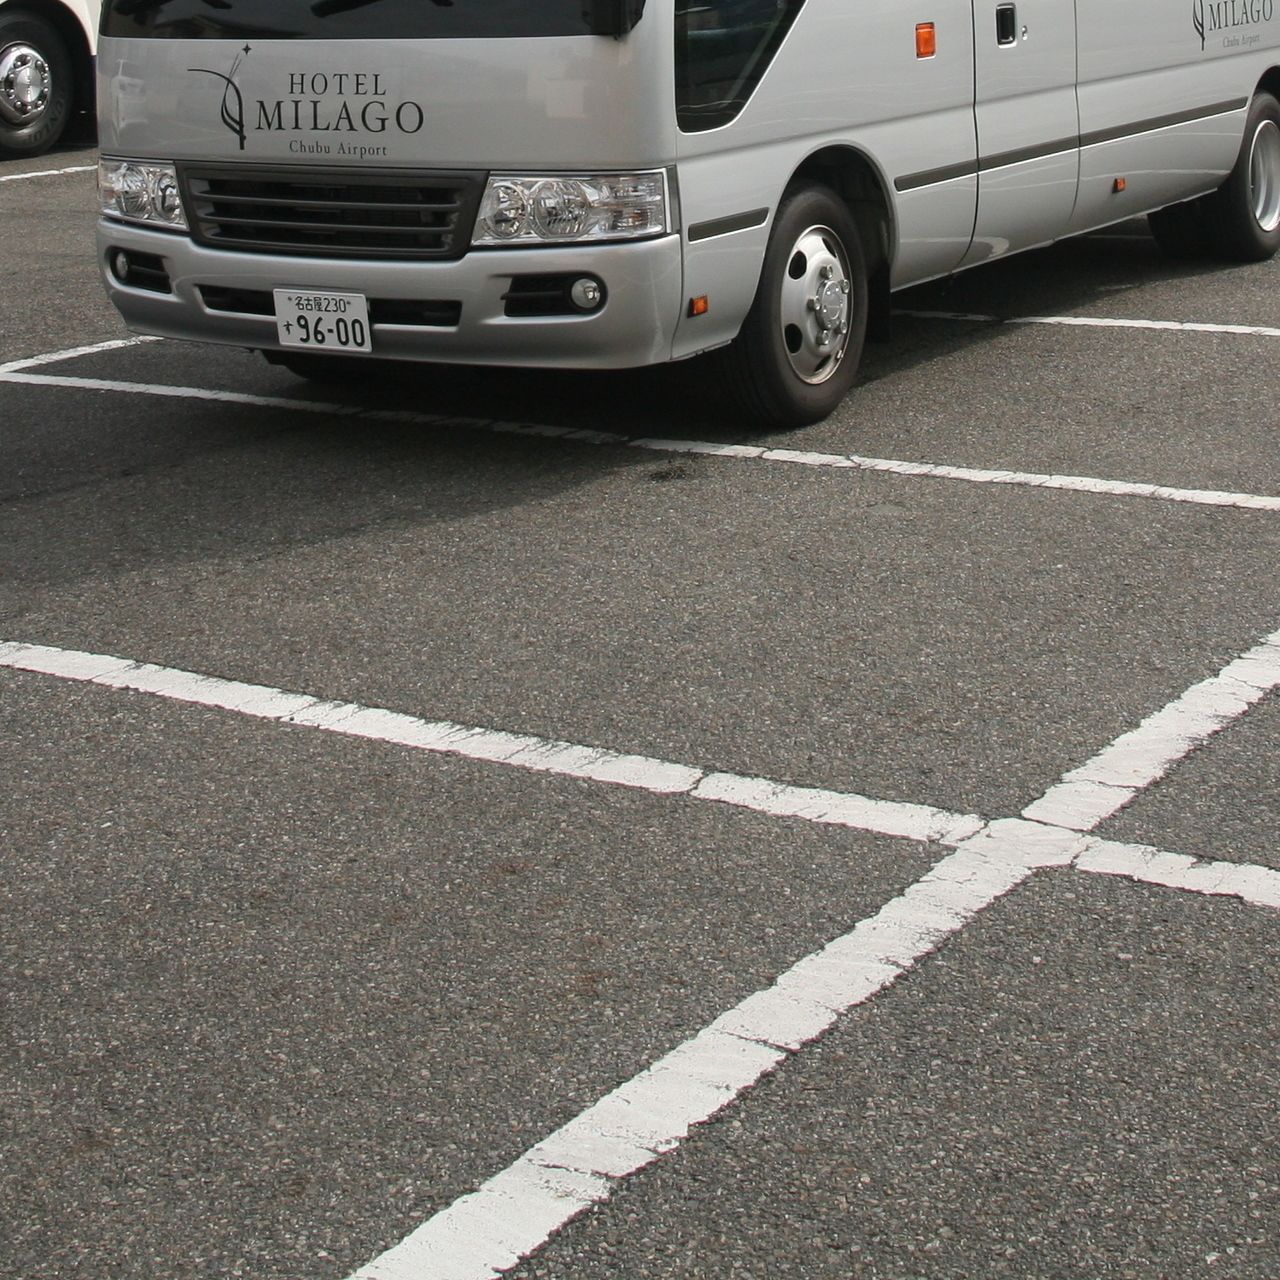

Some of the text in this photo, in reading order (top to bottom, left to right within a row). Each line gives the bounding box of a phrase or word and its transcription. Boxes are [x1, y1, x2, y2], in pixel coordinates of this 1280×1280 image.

[288, 72, 387, 96] HOTEL
[255, 99, 424, 133] MILAGO
[289, 139, 388, 159] Chubu Airport
[296, 314, 366, 348] 96-00
